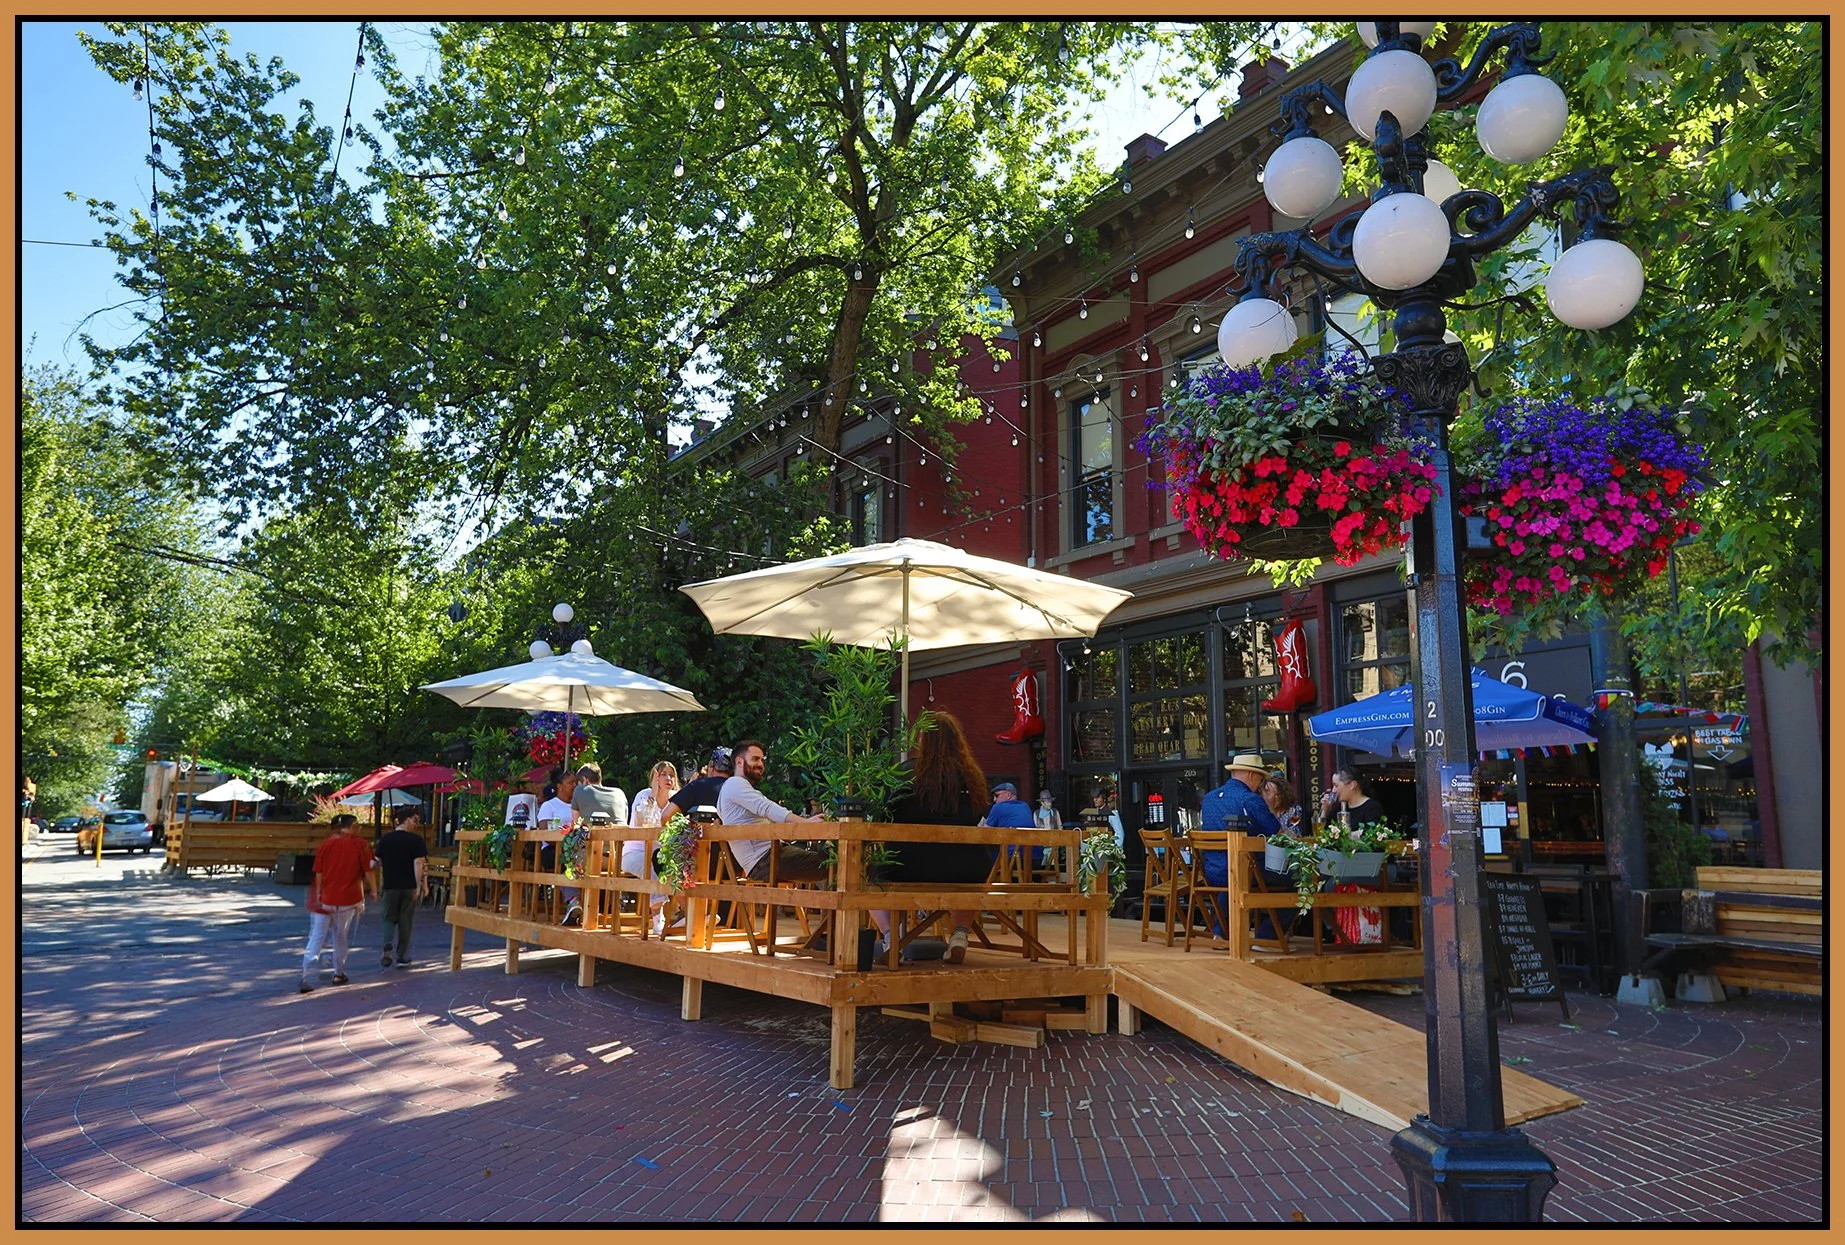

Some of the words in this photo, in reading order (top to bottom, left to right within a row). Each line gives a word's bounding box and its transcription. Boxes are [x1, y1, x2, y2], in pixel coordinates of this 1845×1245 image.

[1501, 661, 1527, 690] 6
[1427, 701, 1437, 718] 2
[1474, 705, 1505, 715] 08GIN
[1695, 729, 1714, 737] BEST
[1309, 740, 1318, 771] BOOT
[1311, 777, 1319, 818] CORRA
